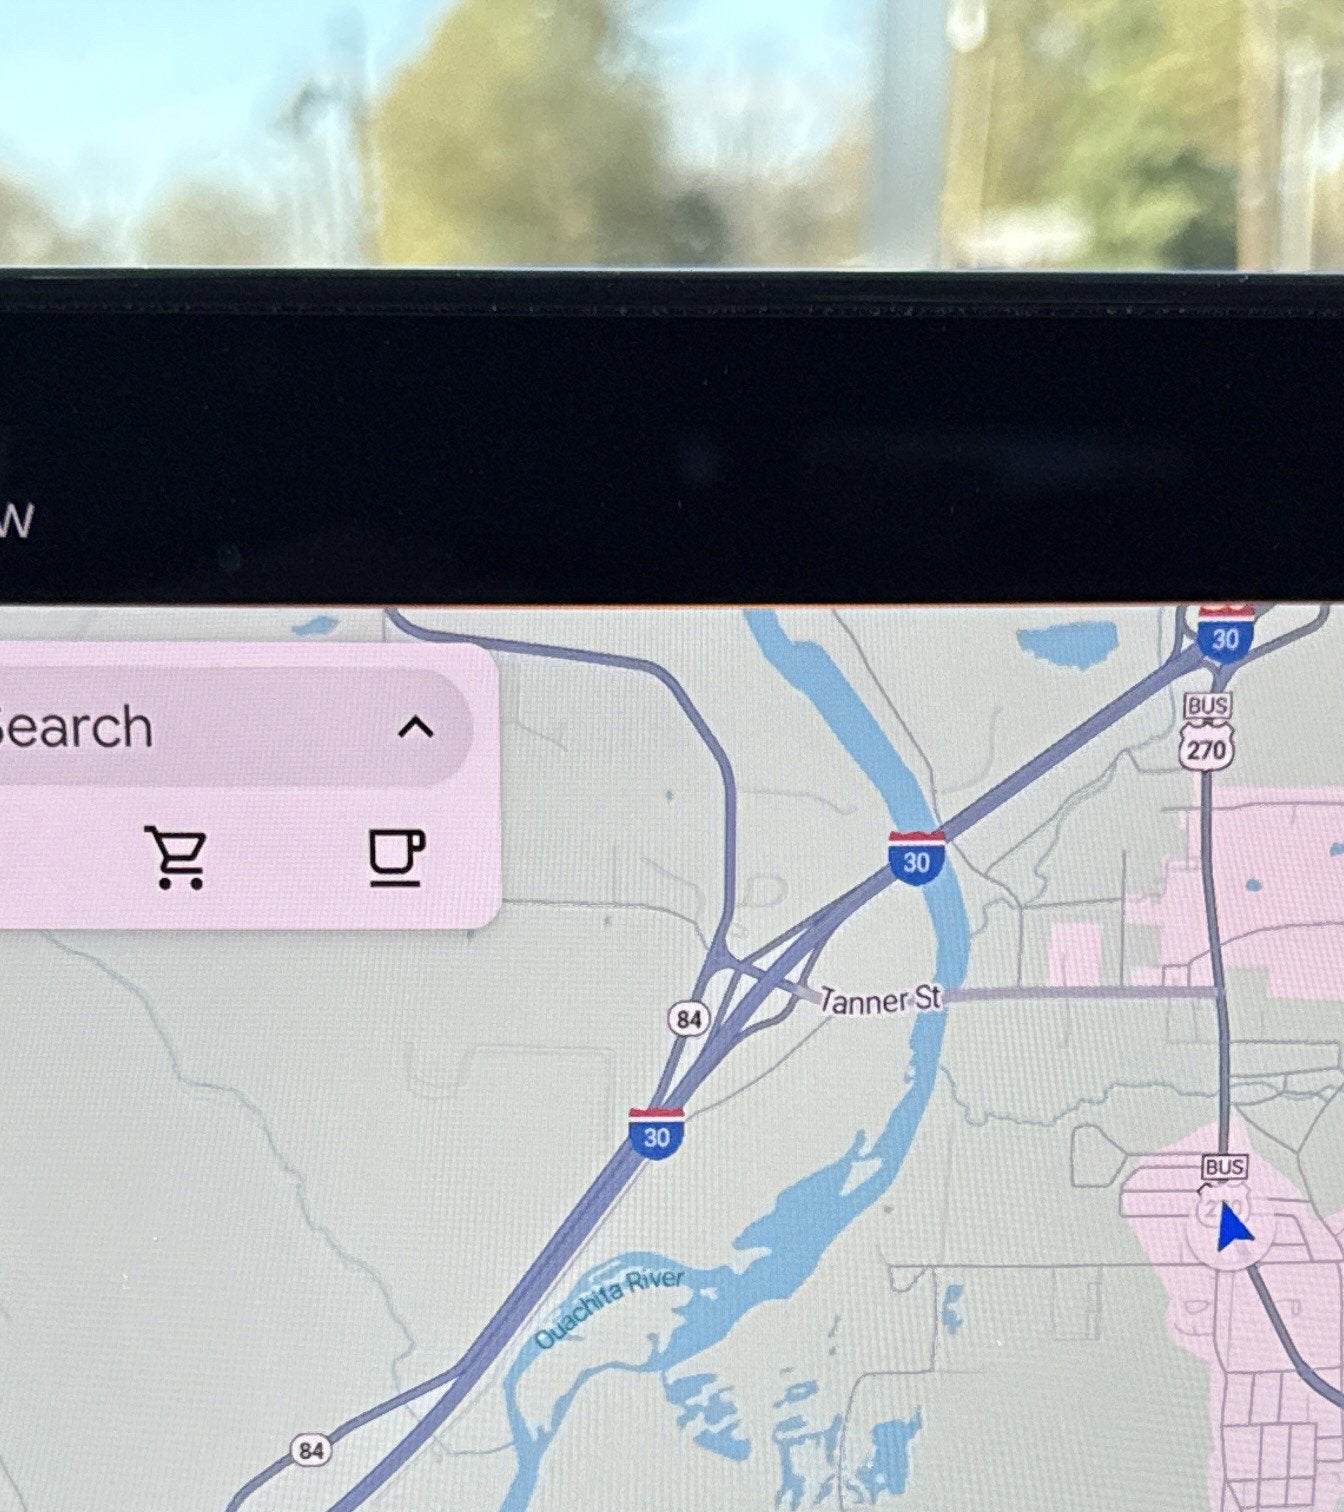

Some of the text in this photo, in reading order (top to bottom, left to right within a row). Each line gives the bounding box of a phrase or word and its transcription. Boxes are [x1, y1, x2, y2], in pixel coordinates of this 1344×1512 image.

[1212, 629, 1238, 651] 30
[1188, 696, 1228, 716] BUS
[1188, 740, 1226, 761] 270
[903, 851, 930, 873] 30
[820, 985, 942, 1014] Tanner St
[677, 1010, 702, 1030] 84
[644, 1126, 670, 1148] 30
[1205, 1158, 1244, 1176] BUS
[535, 1267, 685, 1350] Ouachita River
[299, 1441, 324, 1460] 84
